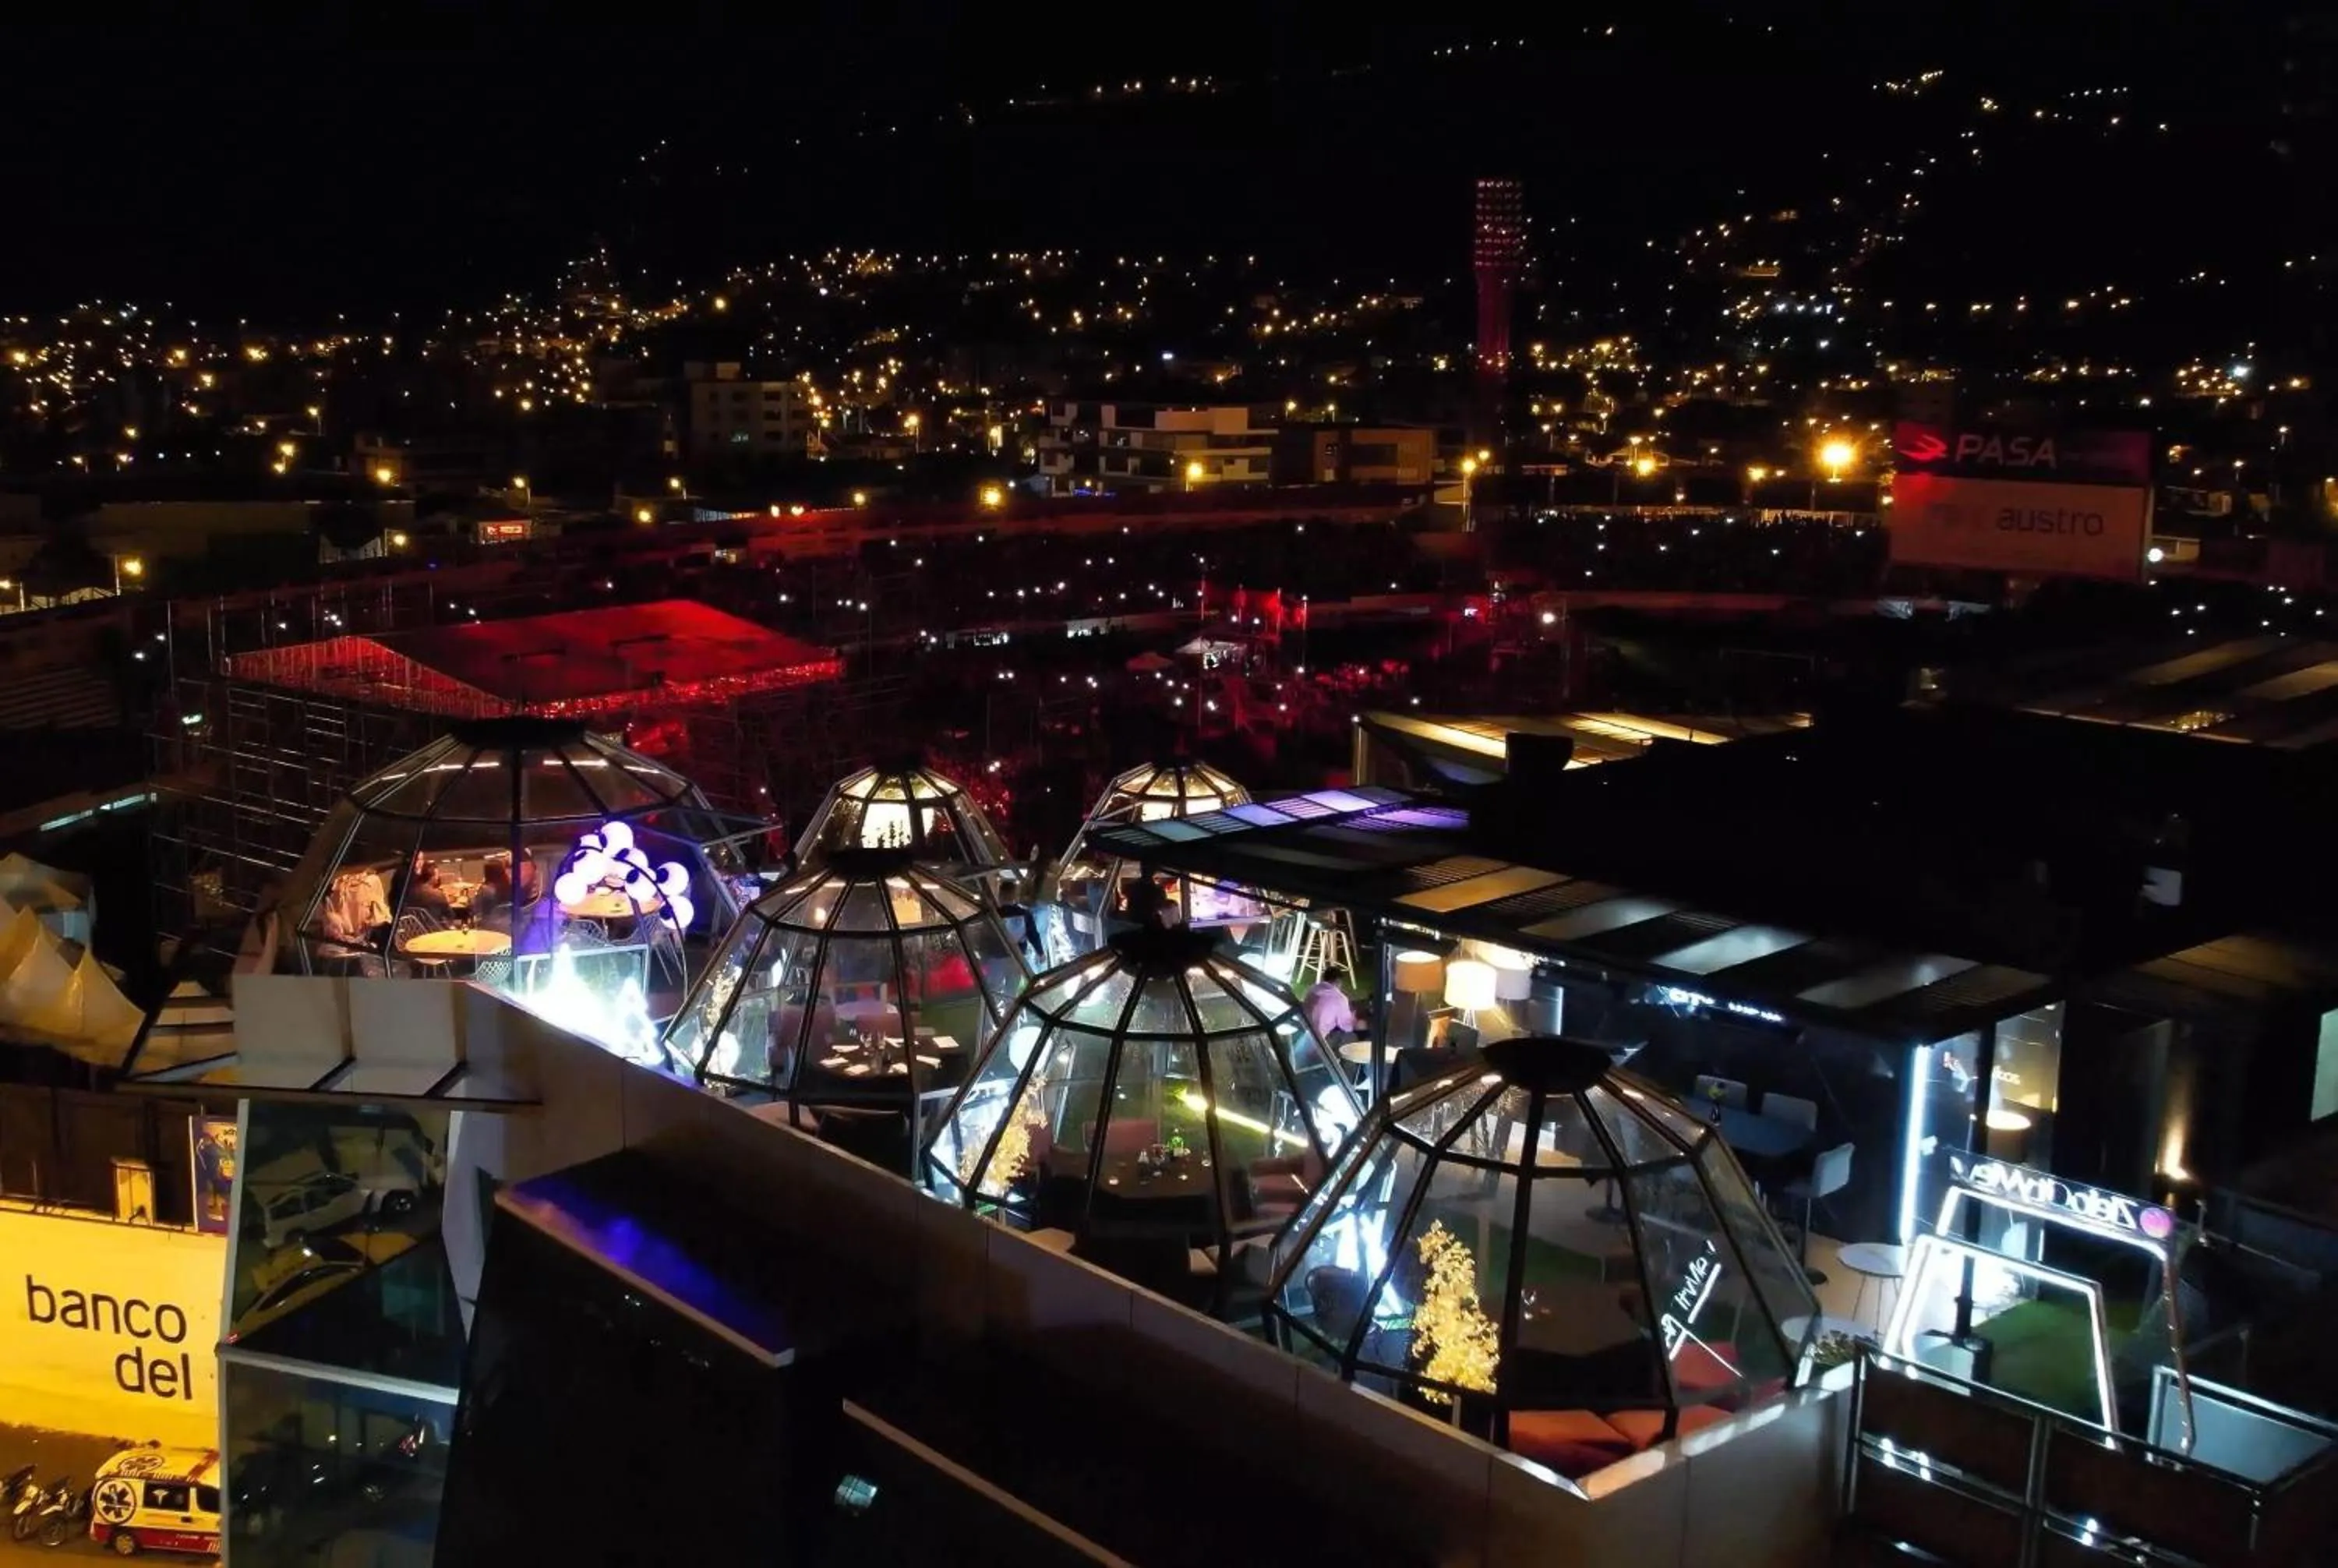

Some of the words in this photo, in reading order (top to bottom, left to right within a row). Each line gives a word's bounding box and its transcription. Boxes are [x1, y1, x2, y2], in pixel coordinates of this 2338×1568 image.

[1955, 433, 2057, 469] PASA
[1997, 507, 2103, 536] austro
[26, 1273, 187, 1344] banco
[115, 1346, 192, 1400] del
